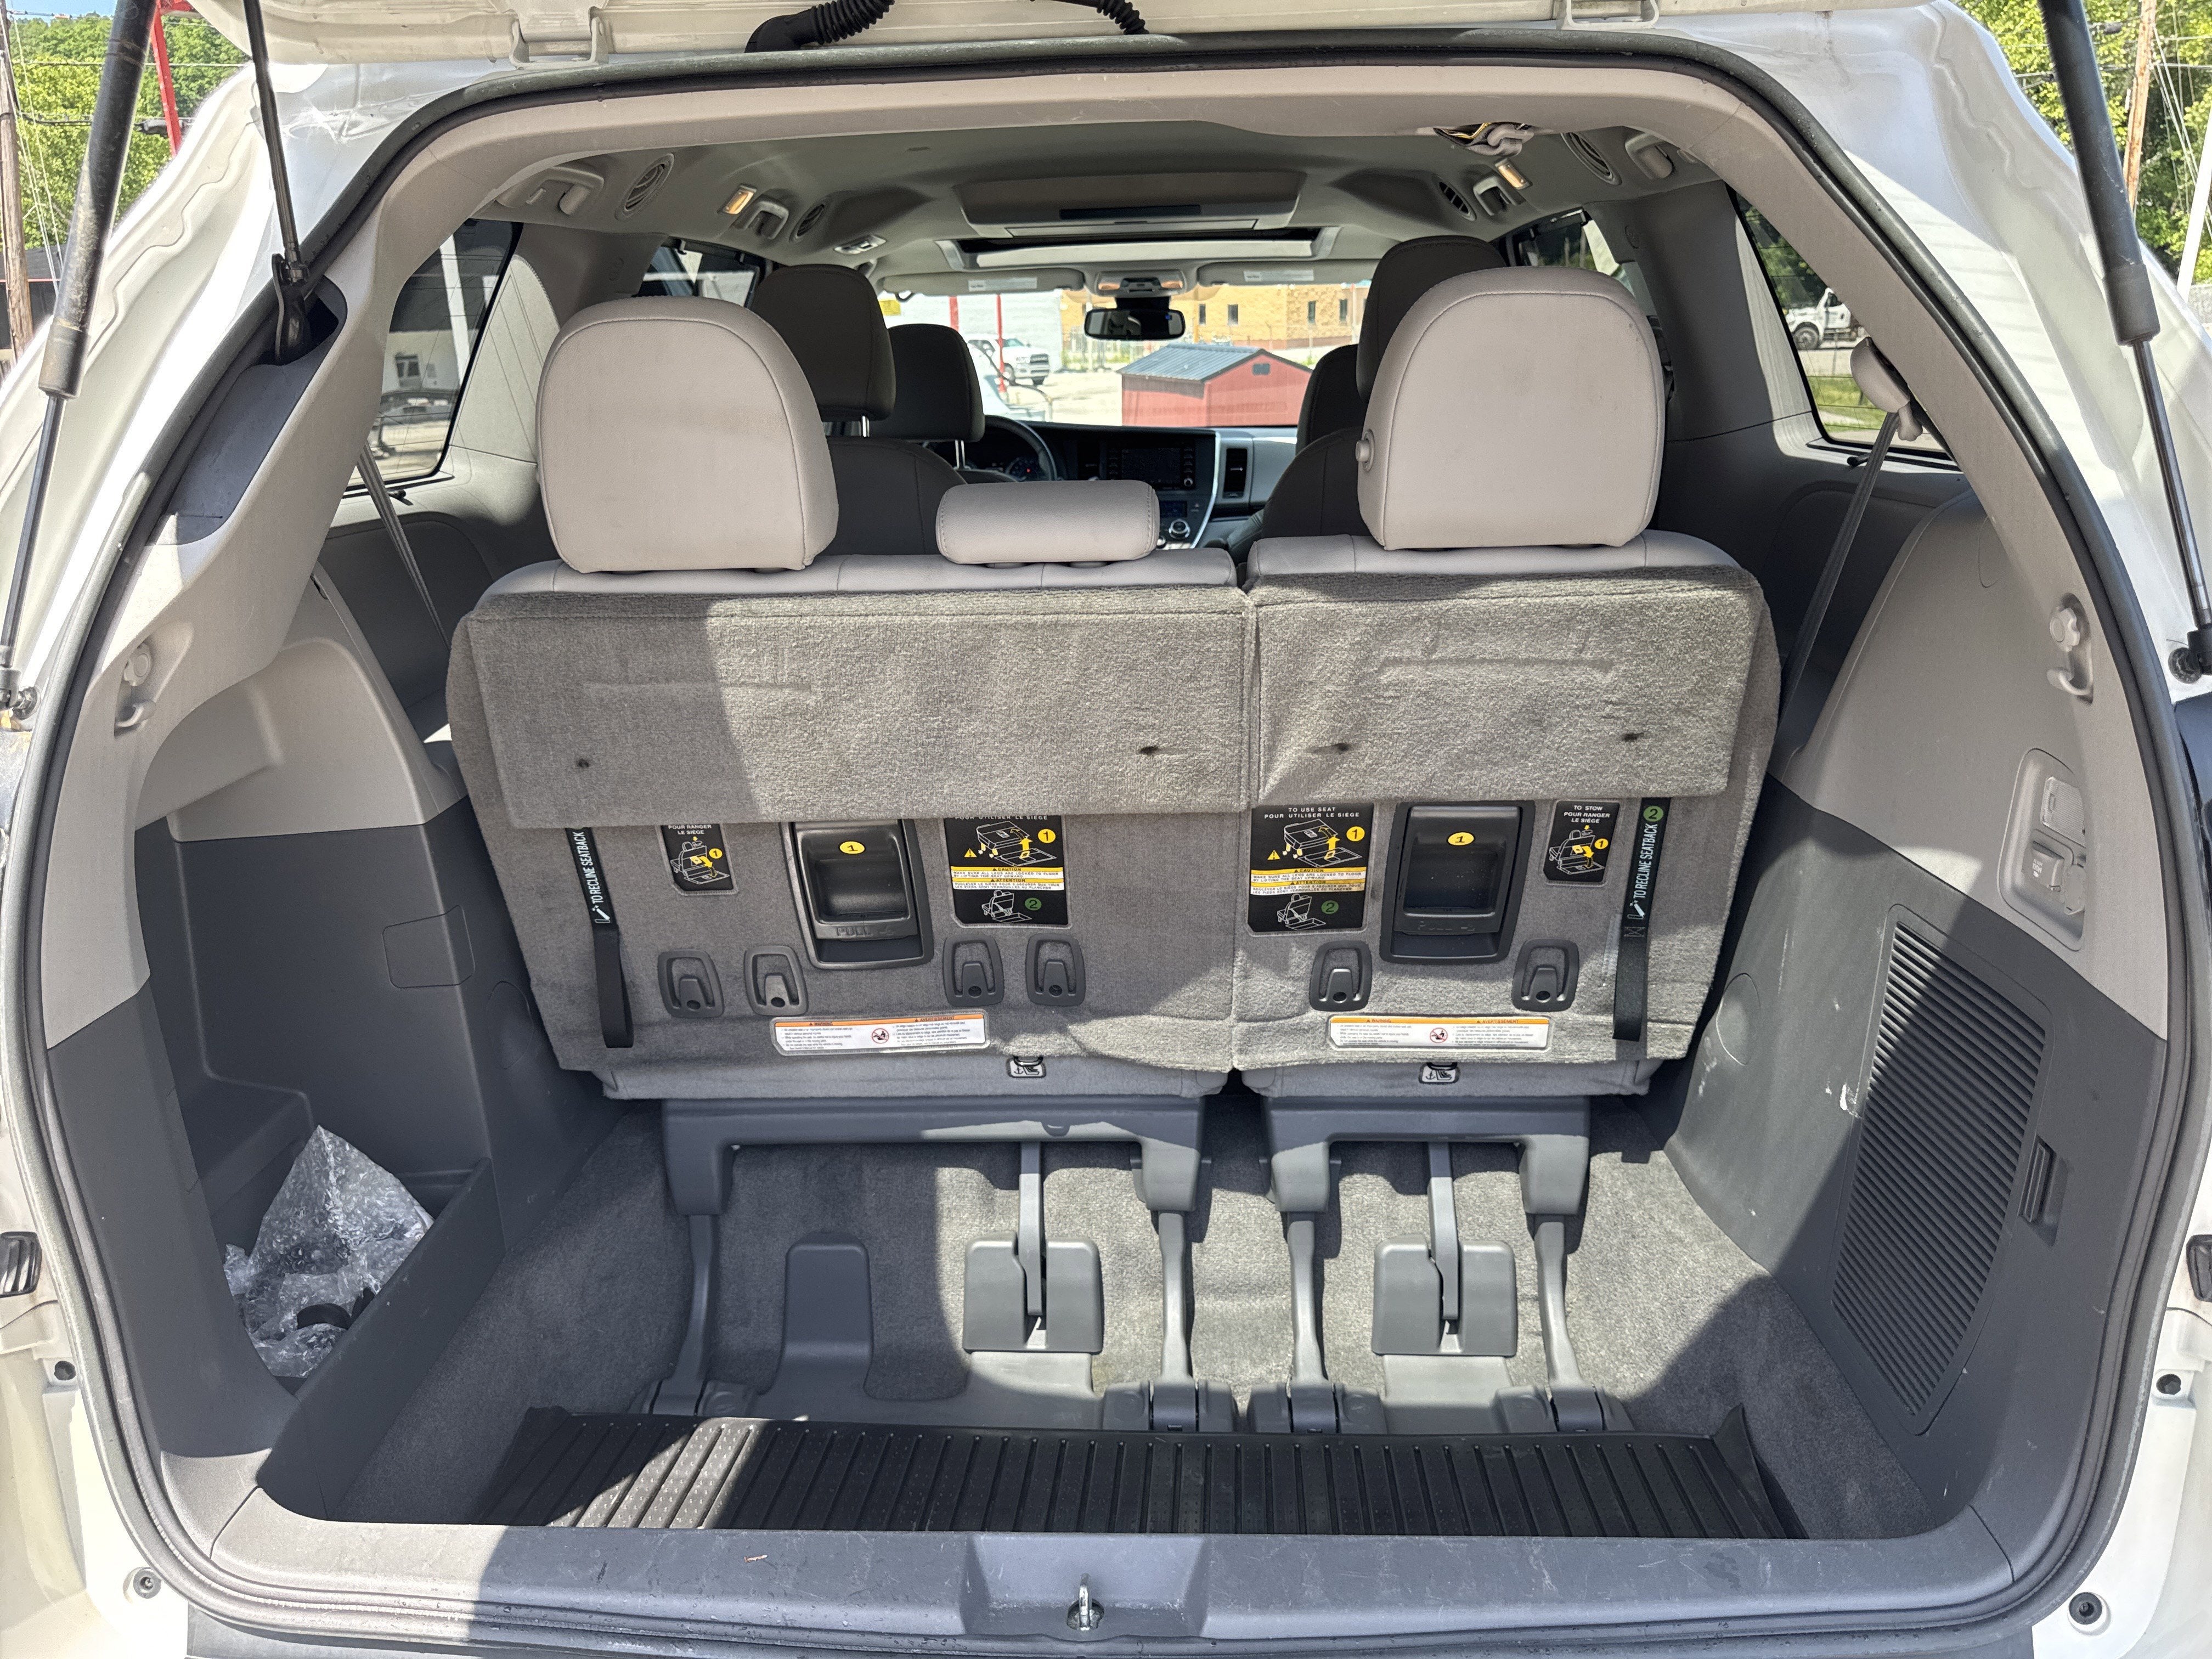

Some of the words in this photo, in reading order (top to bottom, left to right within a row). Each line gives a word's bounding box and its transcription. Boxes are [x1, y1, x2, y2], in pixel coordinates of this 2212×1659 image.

[1648, 808, 1658, 819] 2
[1043, 831, 1048, 841] 1
[1352, 829, 1358, 839] 1
[1640, 823, 1658, 860] SEATBACK
[573, 831, 593, 866] SEATBACK
[583, 867, 602, 894] RECLINE
[1634, 861, 1651, 890] RECLINE
[592, 895, 603, 904] TO
[1633, 890, 1646, 899] TO
[1029, 900, 1037, 909] 2
[1325, 902, 1334, 912] 2
[837, 926, 872, 937] PULL
